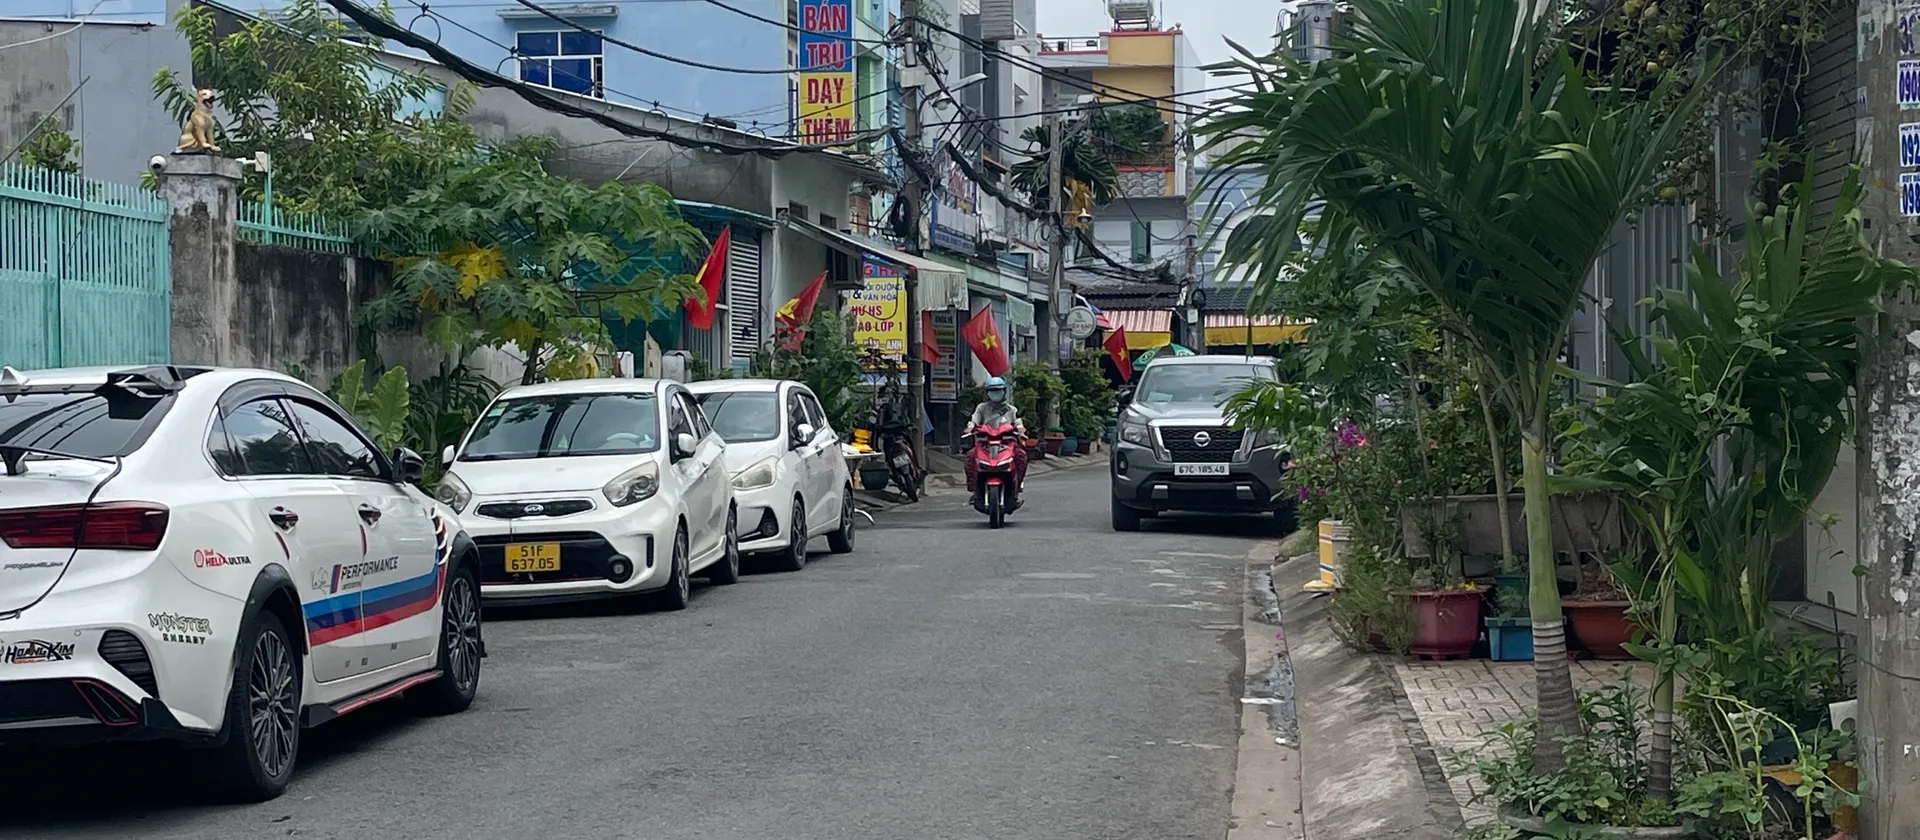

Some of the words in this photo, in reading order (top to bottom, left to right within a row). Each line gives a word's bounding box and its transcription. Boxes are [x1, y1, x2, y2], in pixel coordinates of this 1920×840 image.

[804, 0, 847, 32] BÁN
[807, 78, 845, 111] DẠY
[804, 112, 851, 146] THÊM
[228, 556, 252, 566] ULTRA
[511, 557, 555, 570] 637.05
[521, 545, 543, 557] 51F
[341, 555, 400, 580] PERFORMANCE
[147, 611, 213, 636] MONSTER
